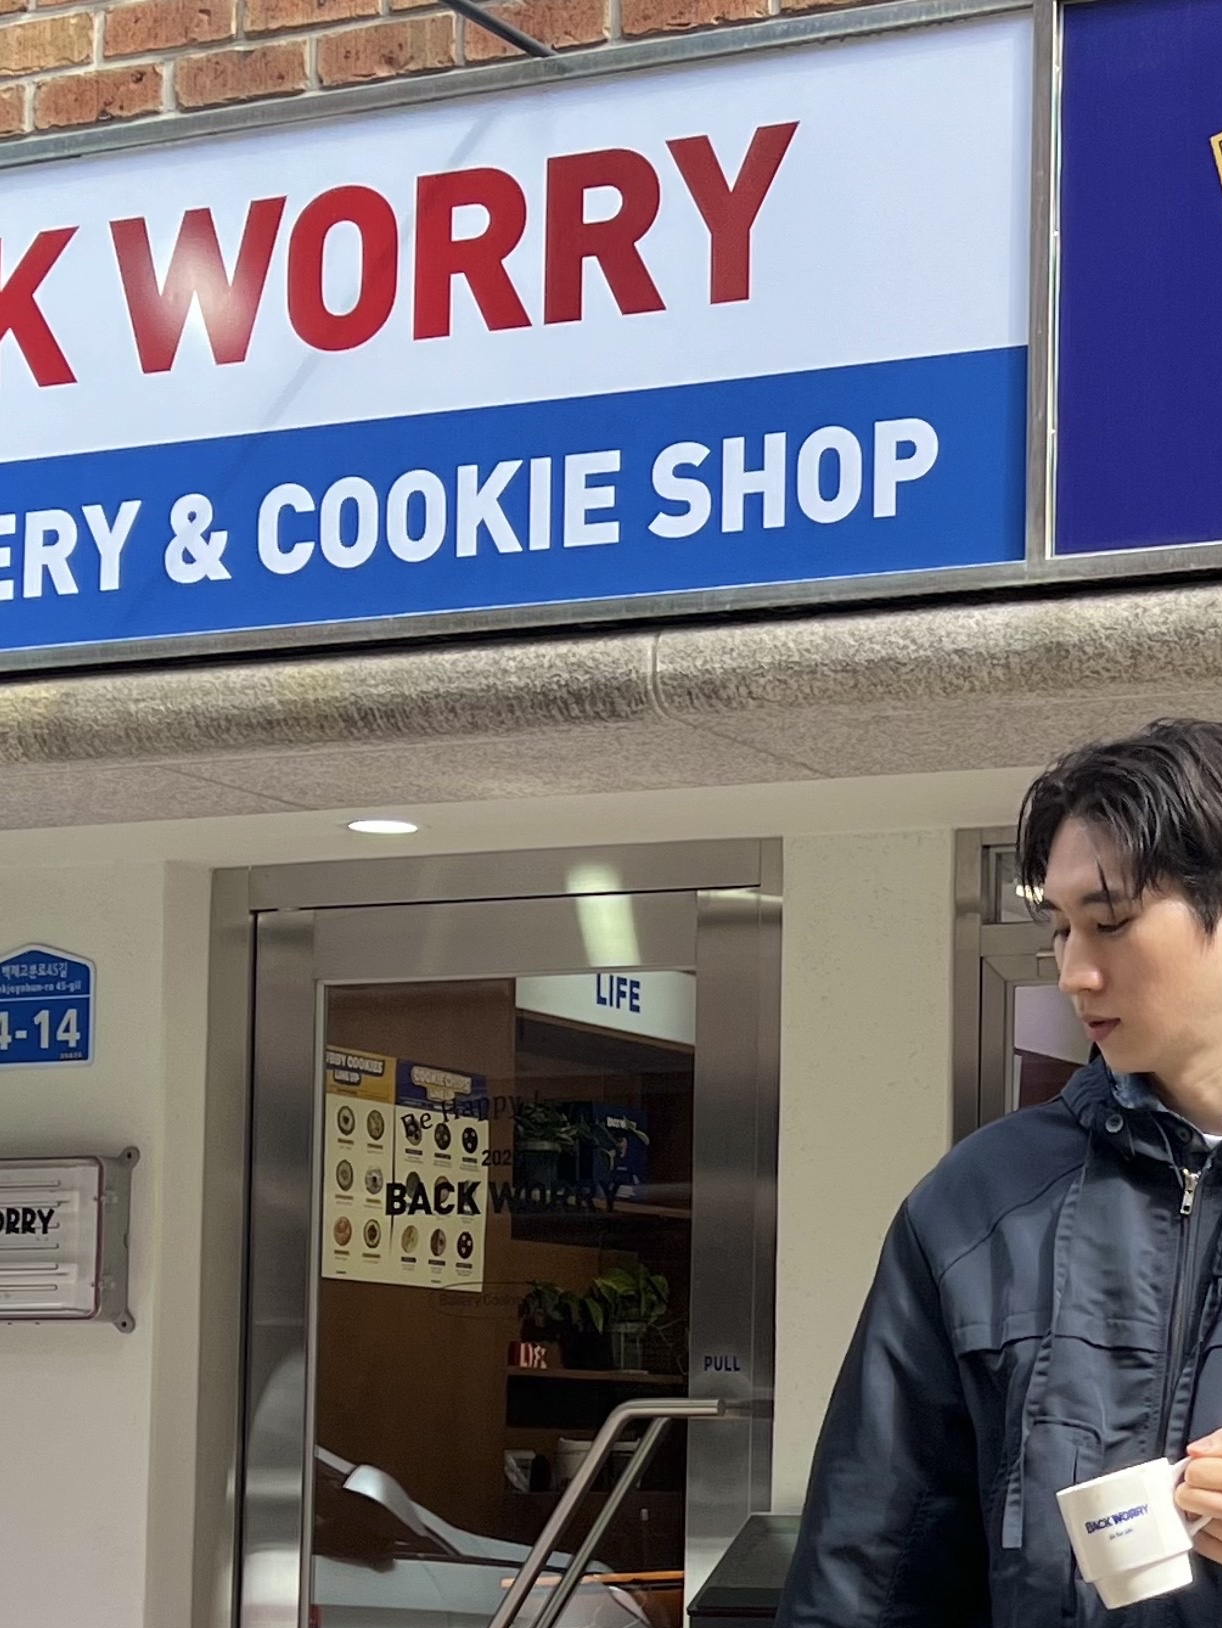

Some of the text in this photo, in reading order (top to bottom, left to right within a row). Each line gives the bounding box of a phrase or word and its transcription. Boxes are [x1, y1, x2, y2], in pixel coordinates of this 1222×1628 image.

[111, 121, 800, 375] WORRY
[165, 493, 231, 585] &
[257, 449, 621, 575] COOKIE
[647, 417, 939, 539] SHOP
[596, 973, 641, 1013] LIFE
[385, 1181, 482, 1215] BACK
[0, 1207, 55, 1235] RRY
[703, 1355, 741, 1372] PULL
